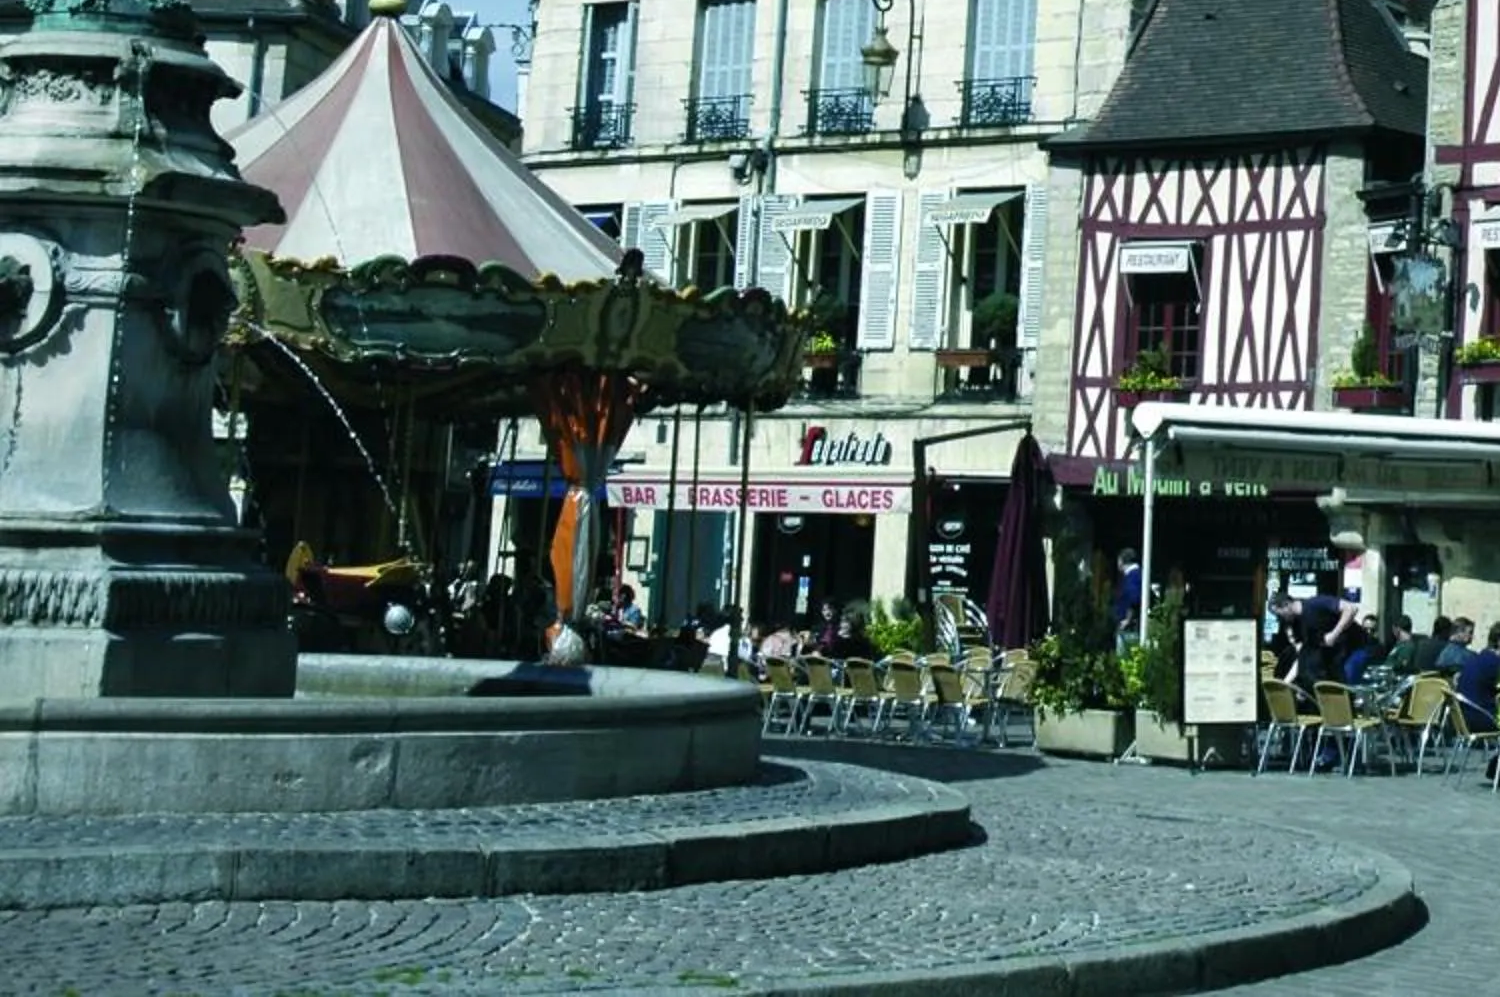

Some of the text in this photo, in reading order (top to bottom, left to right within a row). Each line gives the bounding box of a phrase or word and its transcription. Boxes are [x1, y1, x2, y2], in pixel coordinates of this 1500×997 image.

[1093, 466, 1119, 495] Au
[1128, 467, 1190, 496] Mulin
[622, 486, 656, 505] BAR
[688, 487, 788, 508] BRASSERIE
[821, 489, 893, 509] GLACES
